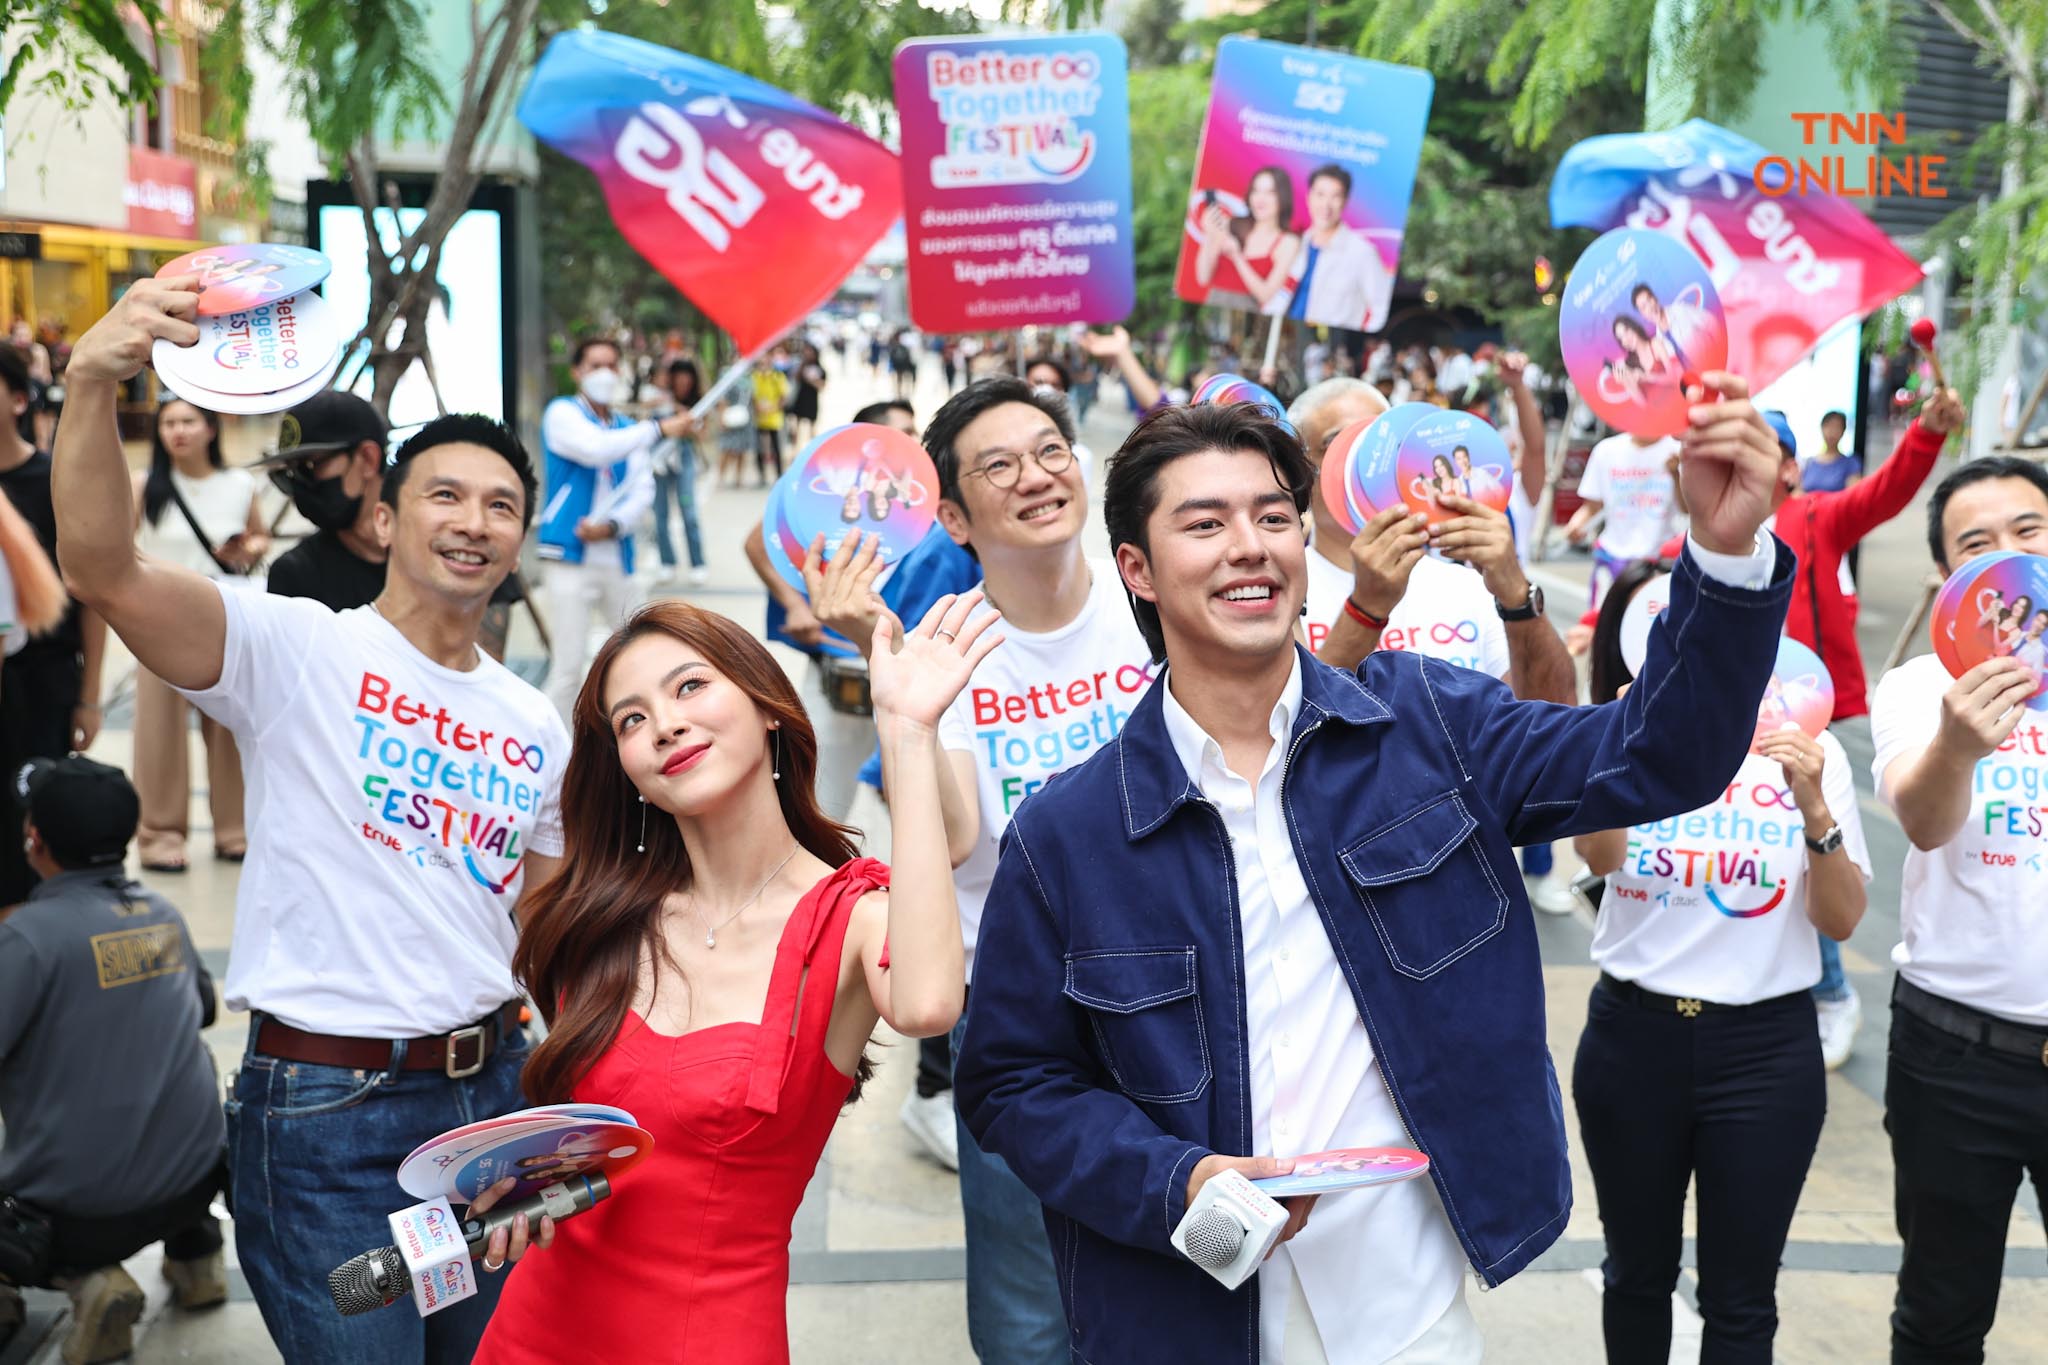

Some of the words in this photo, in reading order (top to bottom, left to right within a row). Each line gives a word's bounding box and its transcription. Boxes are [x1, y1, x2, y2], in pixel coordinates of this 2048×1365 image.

[934, 57, 1044, 87] Better
[937, 84, 1098, 124] Together
[252, 303, 278, 370] ogether
[357, 672, 494, 756] Better
[972, 671, 1107, 726] Better
[976, 703, 1131, 769] Togeth
[355, 714, 542, 817] Together
[362, 822, 403, 852] true
[1981, 851, 2017, 867] true
[1616, 885, 1648, 902] true
[406, 1226, 424, 1259] Better
[422, 1281, 437, 1309] Better
